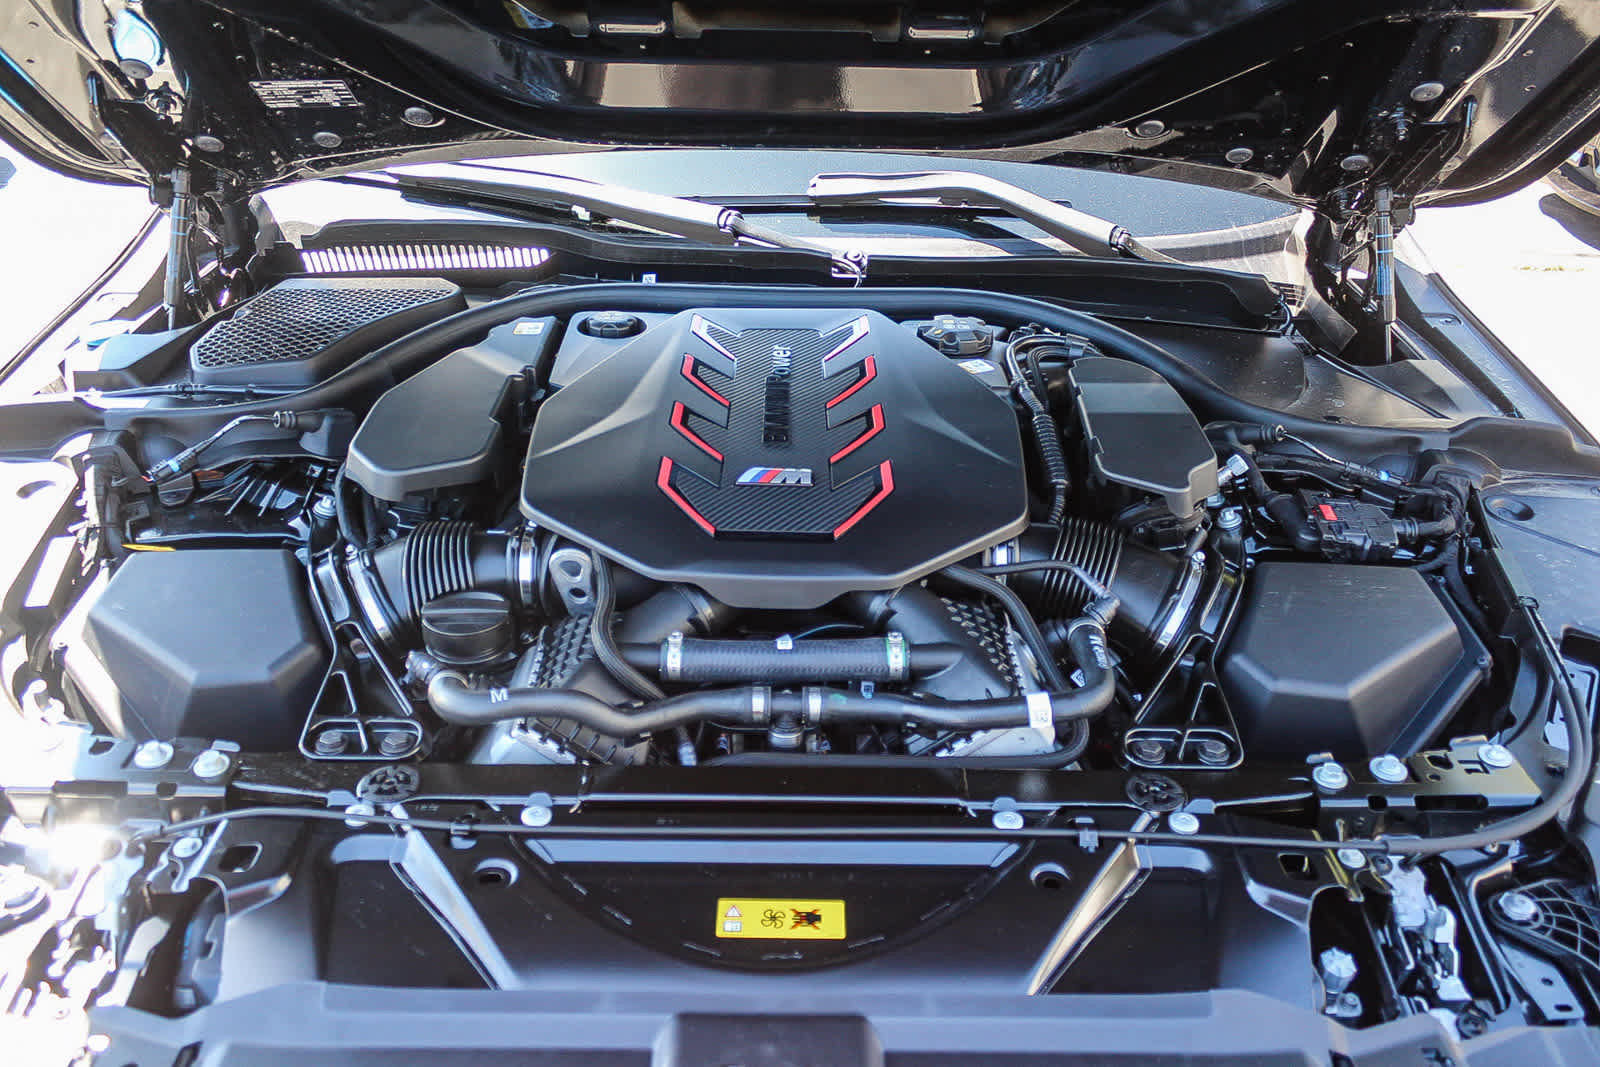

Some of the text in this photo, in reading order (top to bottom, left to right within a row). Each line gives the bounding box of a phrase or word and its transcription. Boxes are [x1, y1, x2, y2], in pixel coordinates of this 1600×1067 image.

[764, 345, 791, 386] Power
[770, 468, 812, 485] M
[489, 687, 509, 704] M
